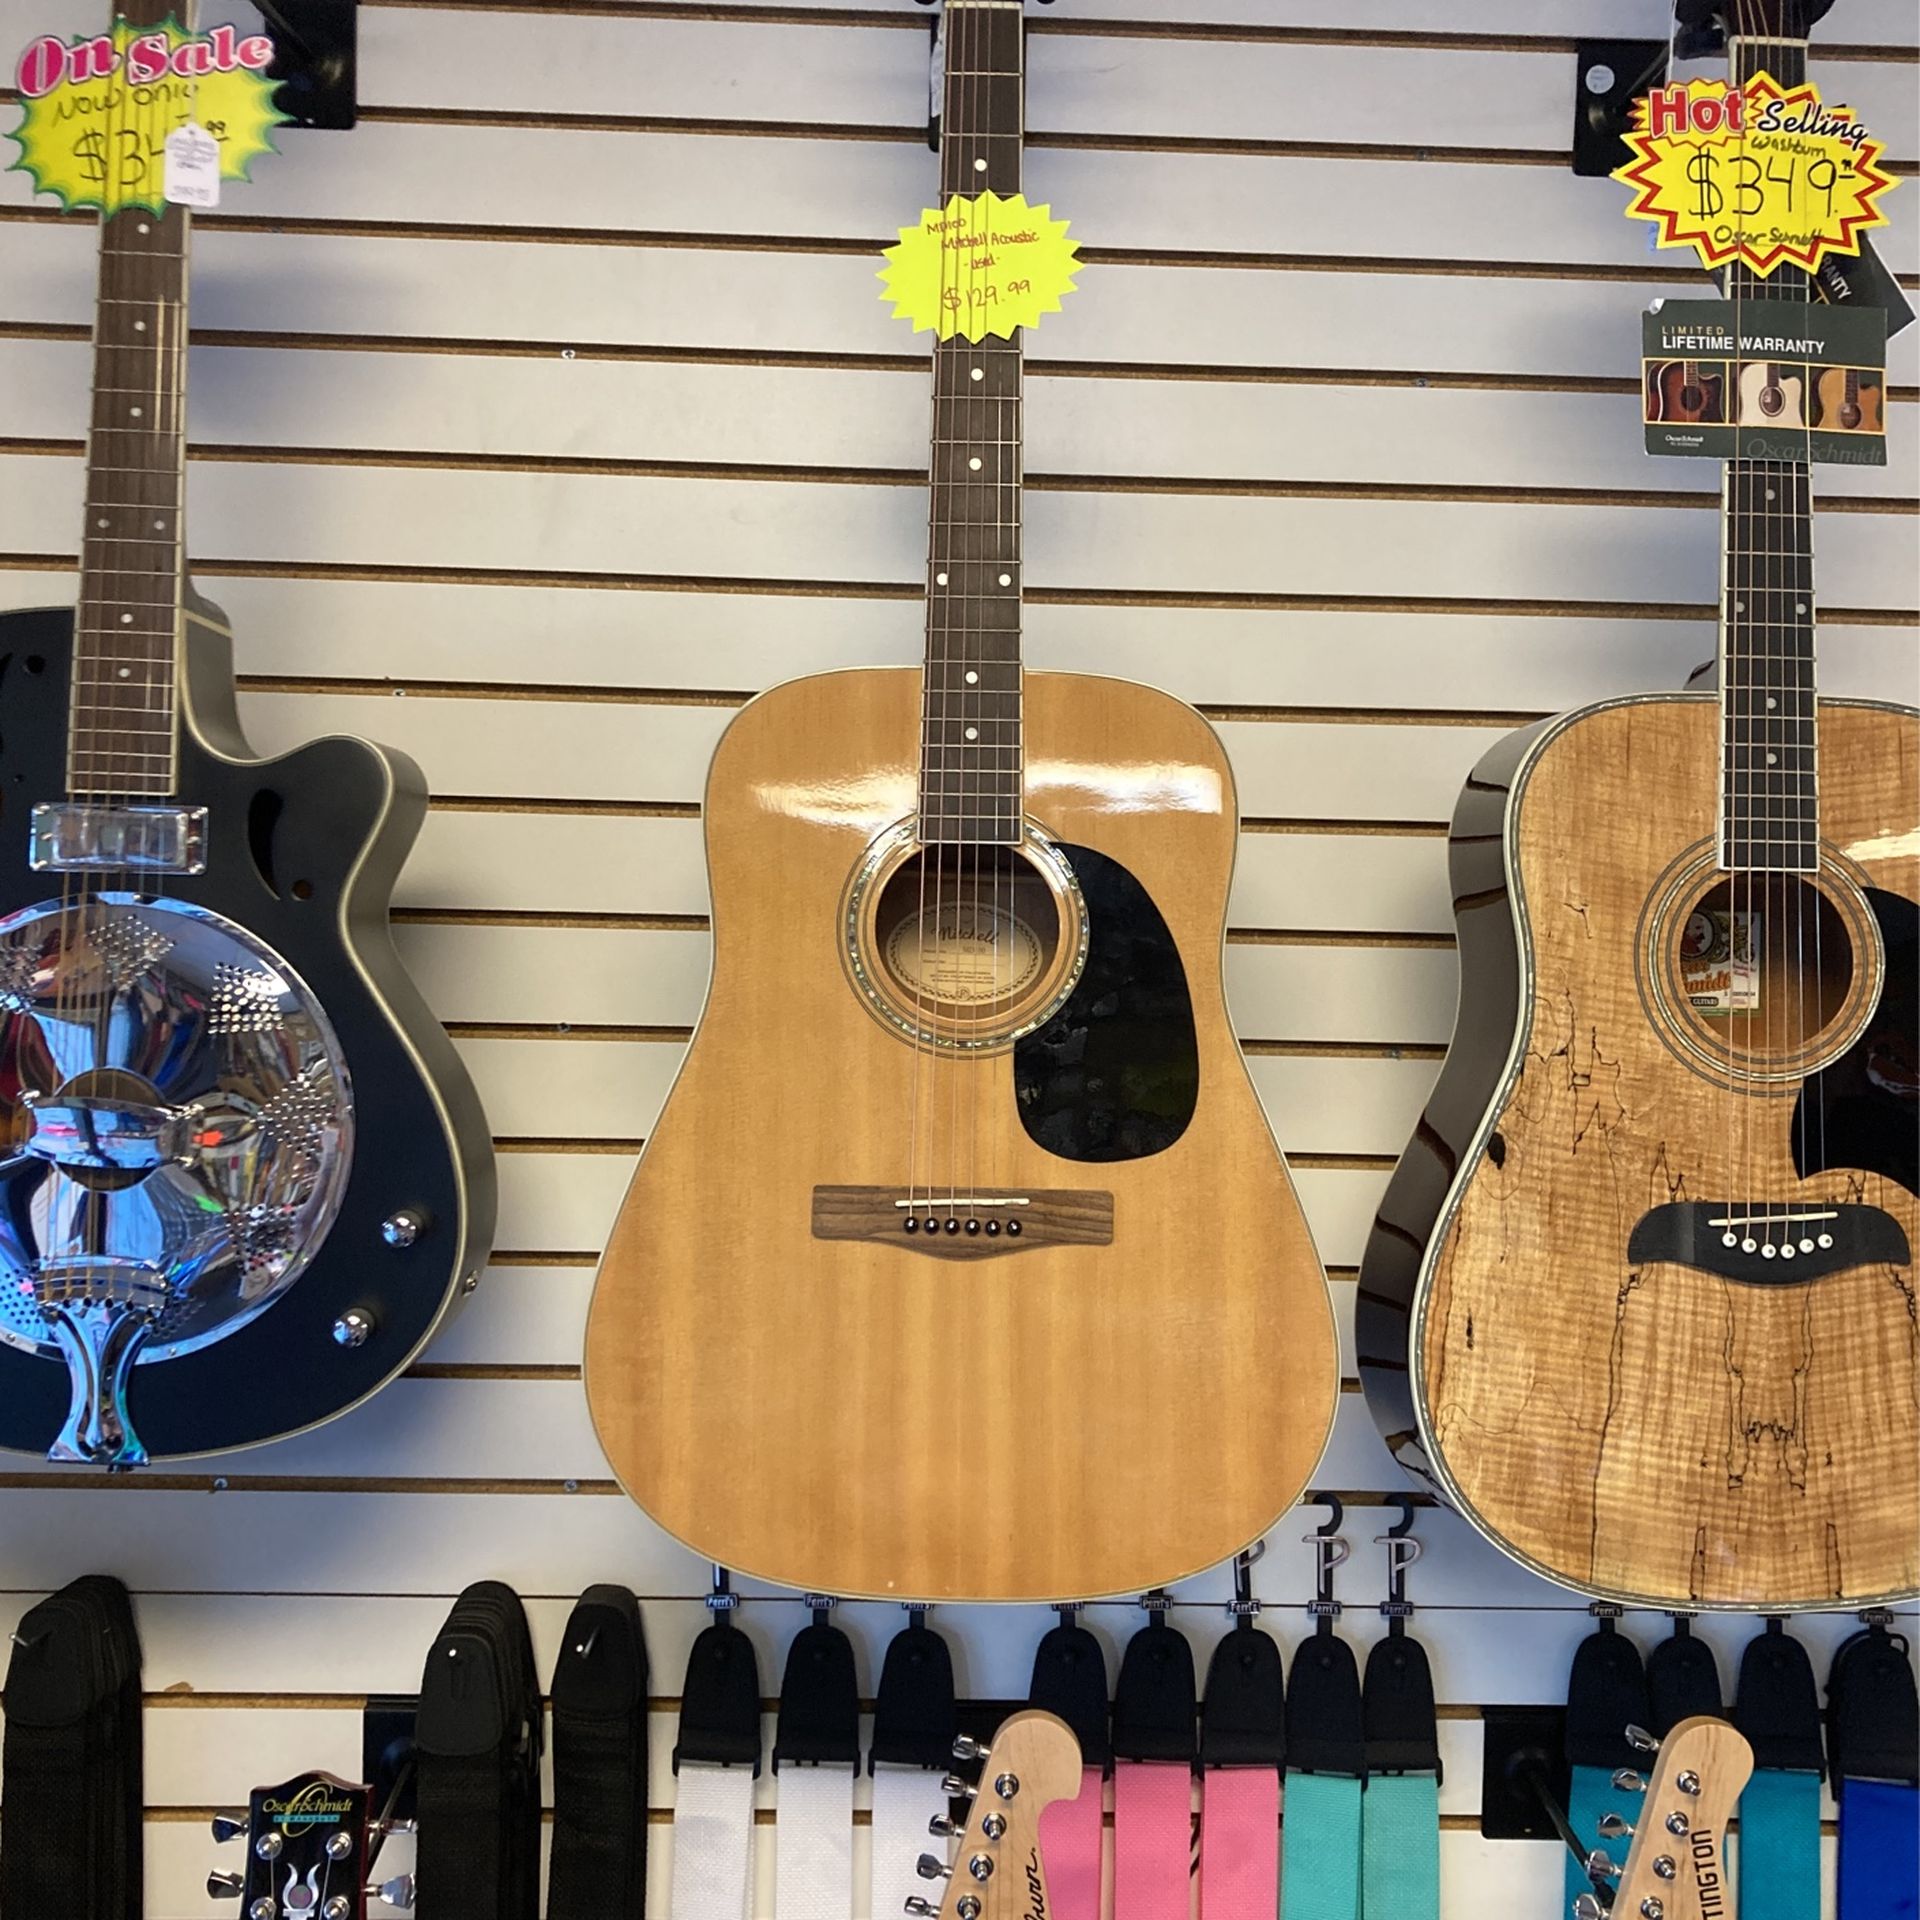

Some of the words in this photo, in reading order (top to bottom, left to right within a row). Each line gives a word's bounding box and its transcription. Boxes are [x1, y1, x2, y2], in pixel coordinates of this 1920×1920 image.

[18, 35, 122, 97] On
[128, 25, 274, 84] Sale
[1650, 88, 1746, 138] Hot
[1757, 100, 1869, 151] Selling
[991, 230, 1040, 247] Acoustic
[1822, 256, 1852, 300] RANTY
[943, 279, 1031, 311] $129.99
[1662, 326, 1725, 336] LIMITED
[1662, 335, 1734, 350] LIFETIME
[1737, 337, 1826, 355] WARRANTY
[930, 925, 999, 945] Mitchell
[1690, 1829, 1724, 1920] TINGTON
